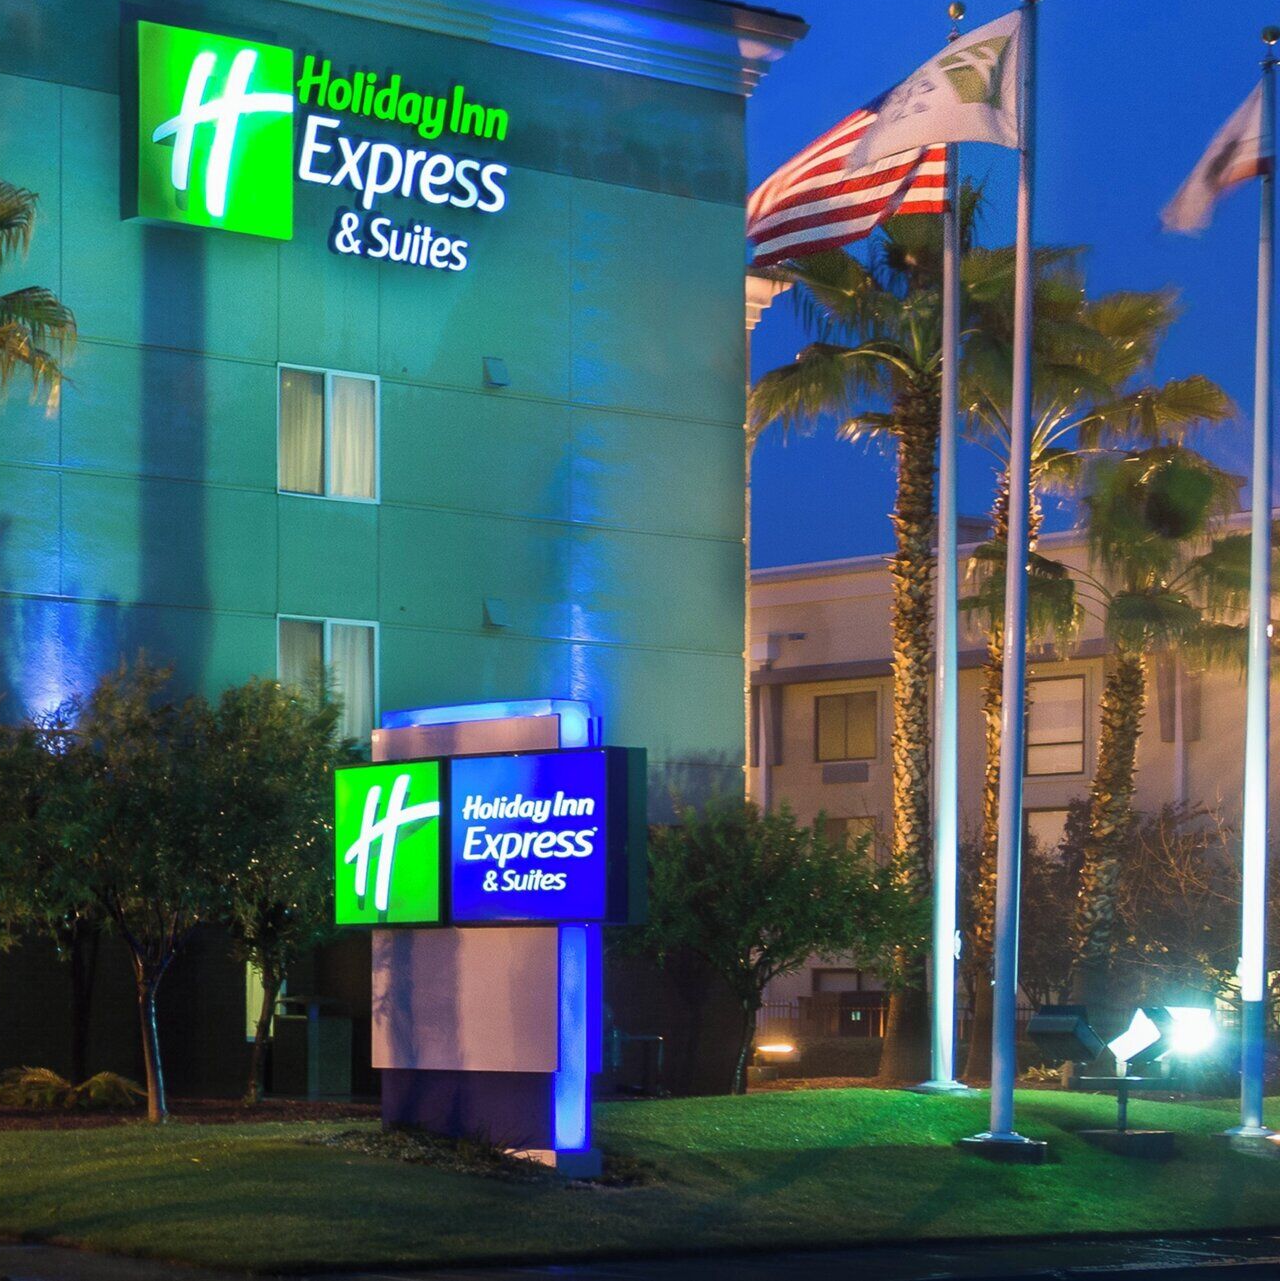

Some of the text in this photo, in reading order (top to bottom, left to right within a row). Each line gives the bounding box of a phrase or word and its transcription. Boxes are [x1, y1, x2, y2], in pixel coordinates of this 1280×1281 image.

[297, 55, 508, 140] Holiday Inn
[298, 114, 508, 213] Express
[335, 212, 469, 272] & Suites
[462, 791, 595, 823] Holiday Inn
[462, 826, 595, 868] Express
[482, 869, 567, 892] & Suites
